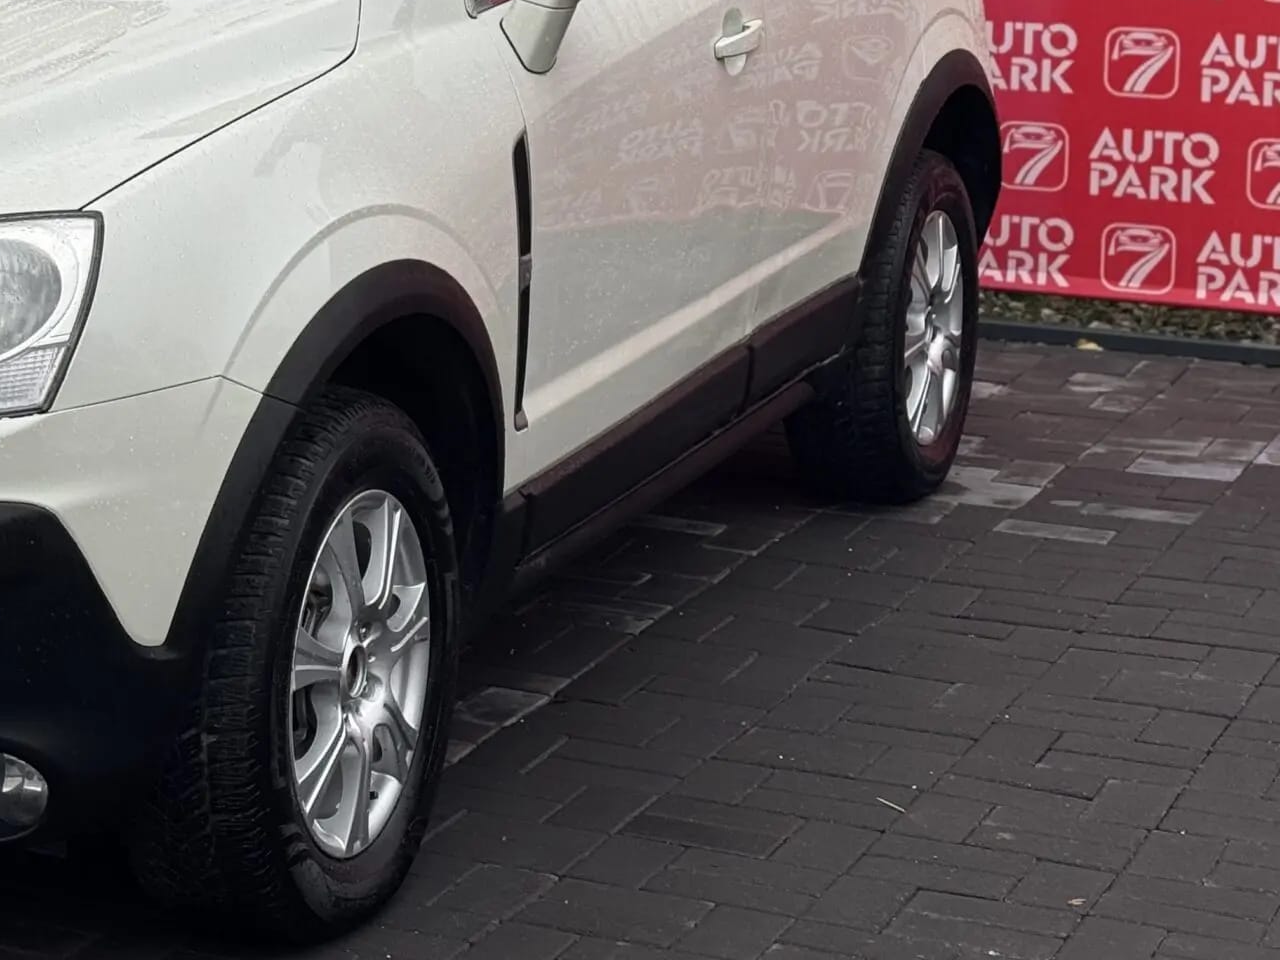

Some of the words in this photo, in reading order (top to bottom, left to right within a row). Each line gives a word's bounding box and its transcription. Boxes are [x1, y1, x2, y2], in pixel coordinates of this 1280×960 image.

[986, 21, 1078, 57] UTO
[990, 55, 1074, 94] ARK
[1200, 68, 1280, 107] PAR
[1090, 128, 1219, 168] AUTO
[1090, 162, 1214, 204] PARK
[984, 214, 1074, 251] UTO
[1196, 230, 1280, 268] AUT
[978, 249, 1069, 288] ARK
[1196, 266, 1280, 306] PAR
